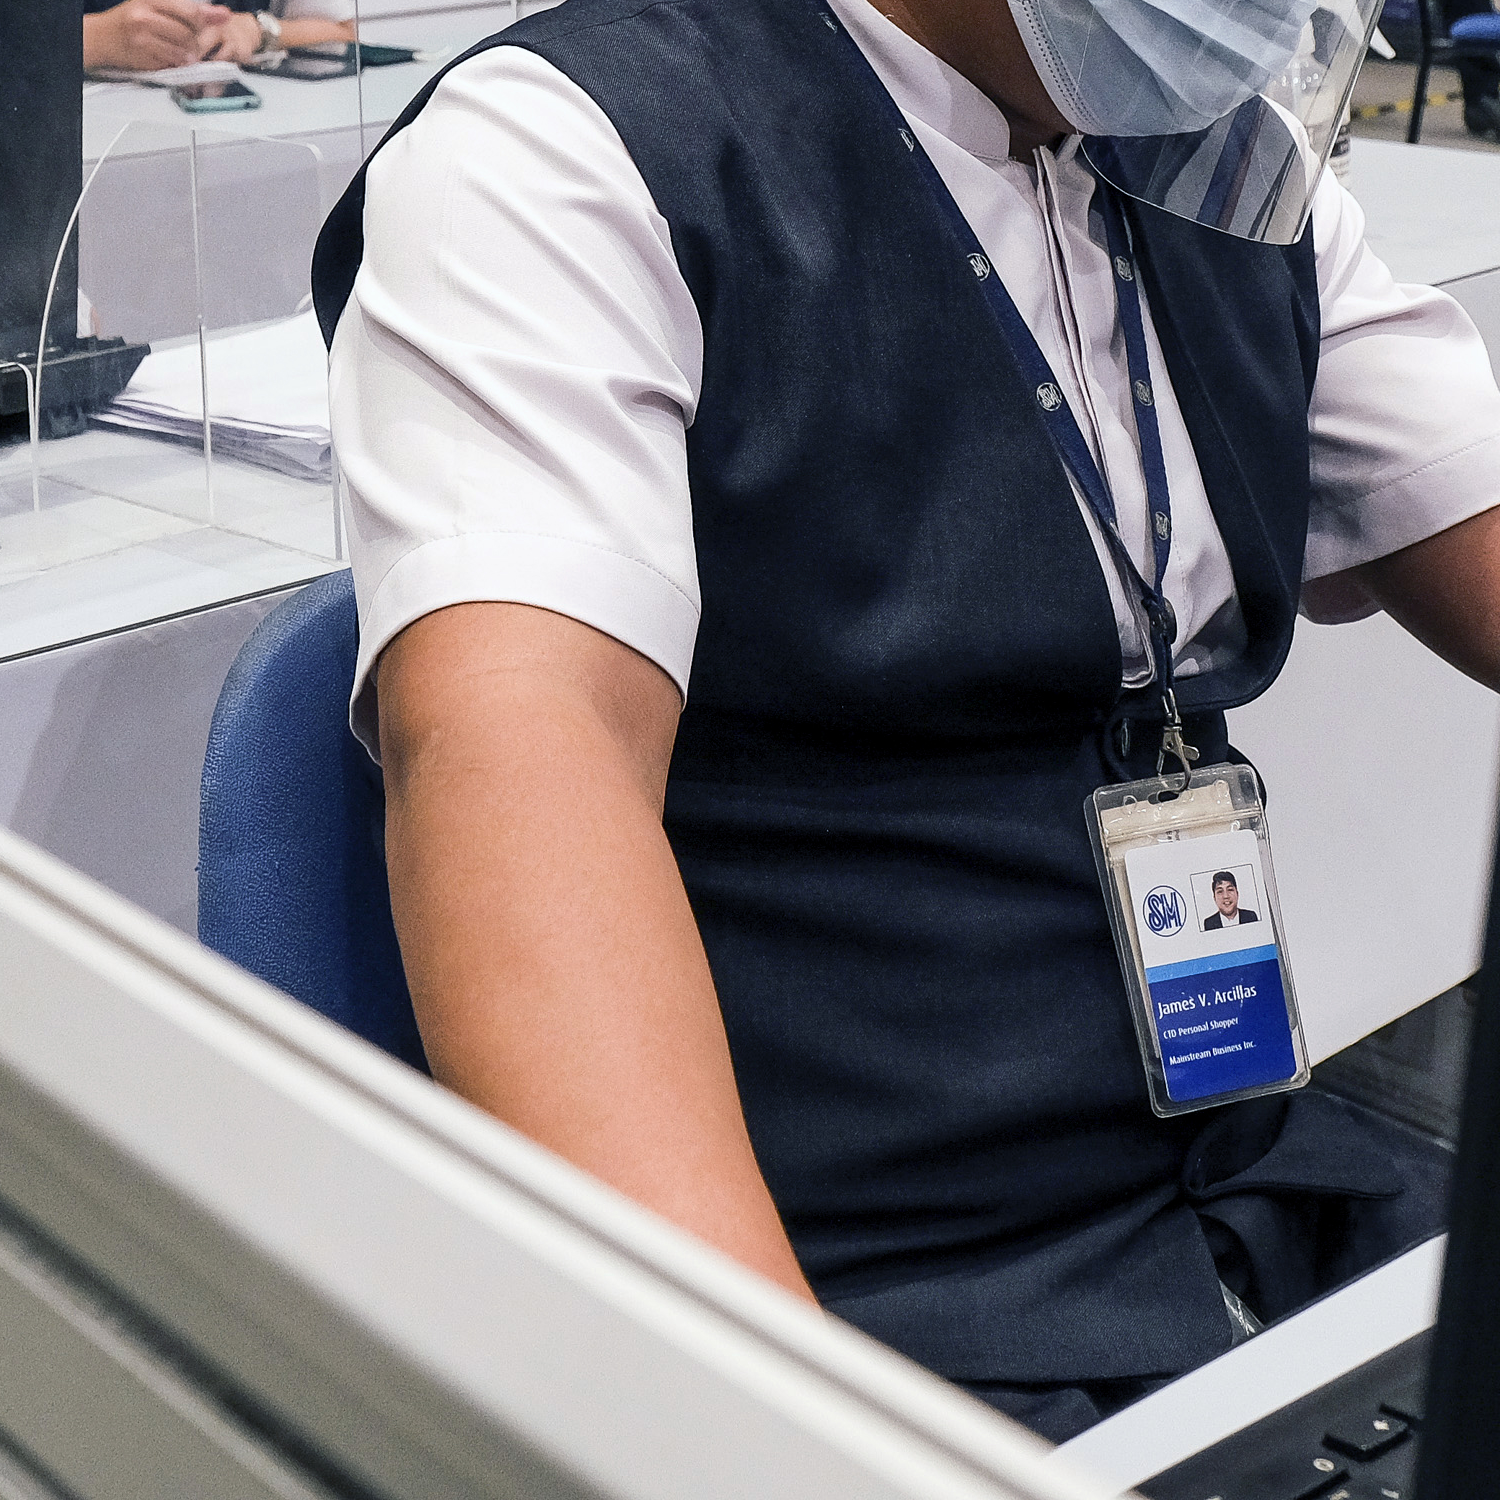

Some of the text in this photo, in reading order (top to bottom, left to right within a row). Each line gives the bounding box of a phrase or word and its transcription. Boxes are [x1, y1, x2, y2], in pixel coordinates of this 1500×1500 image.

[1148, 891, 1183, 932] SM
[1157, 983, 1258, 1020] James V. Arcillas
[1178, 1021, 1209, 1037] Personal
[1210, 1016, 1239, 1031] Shopper
[1169, 1040, 1257, 1066] Mainstream Business Inc.
